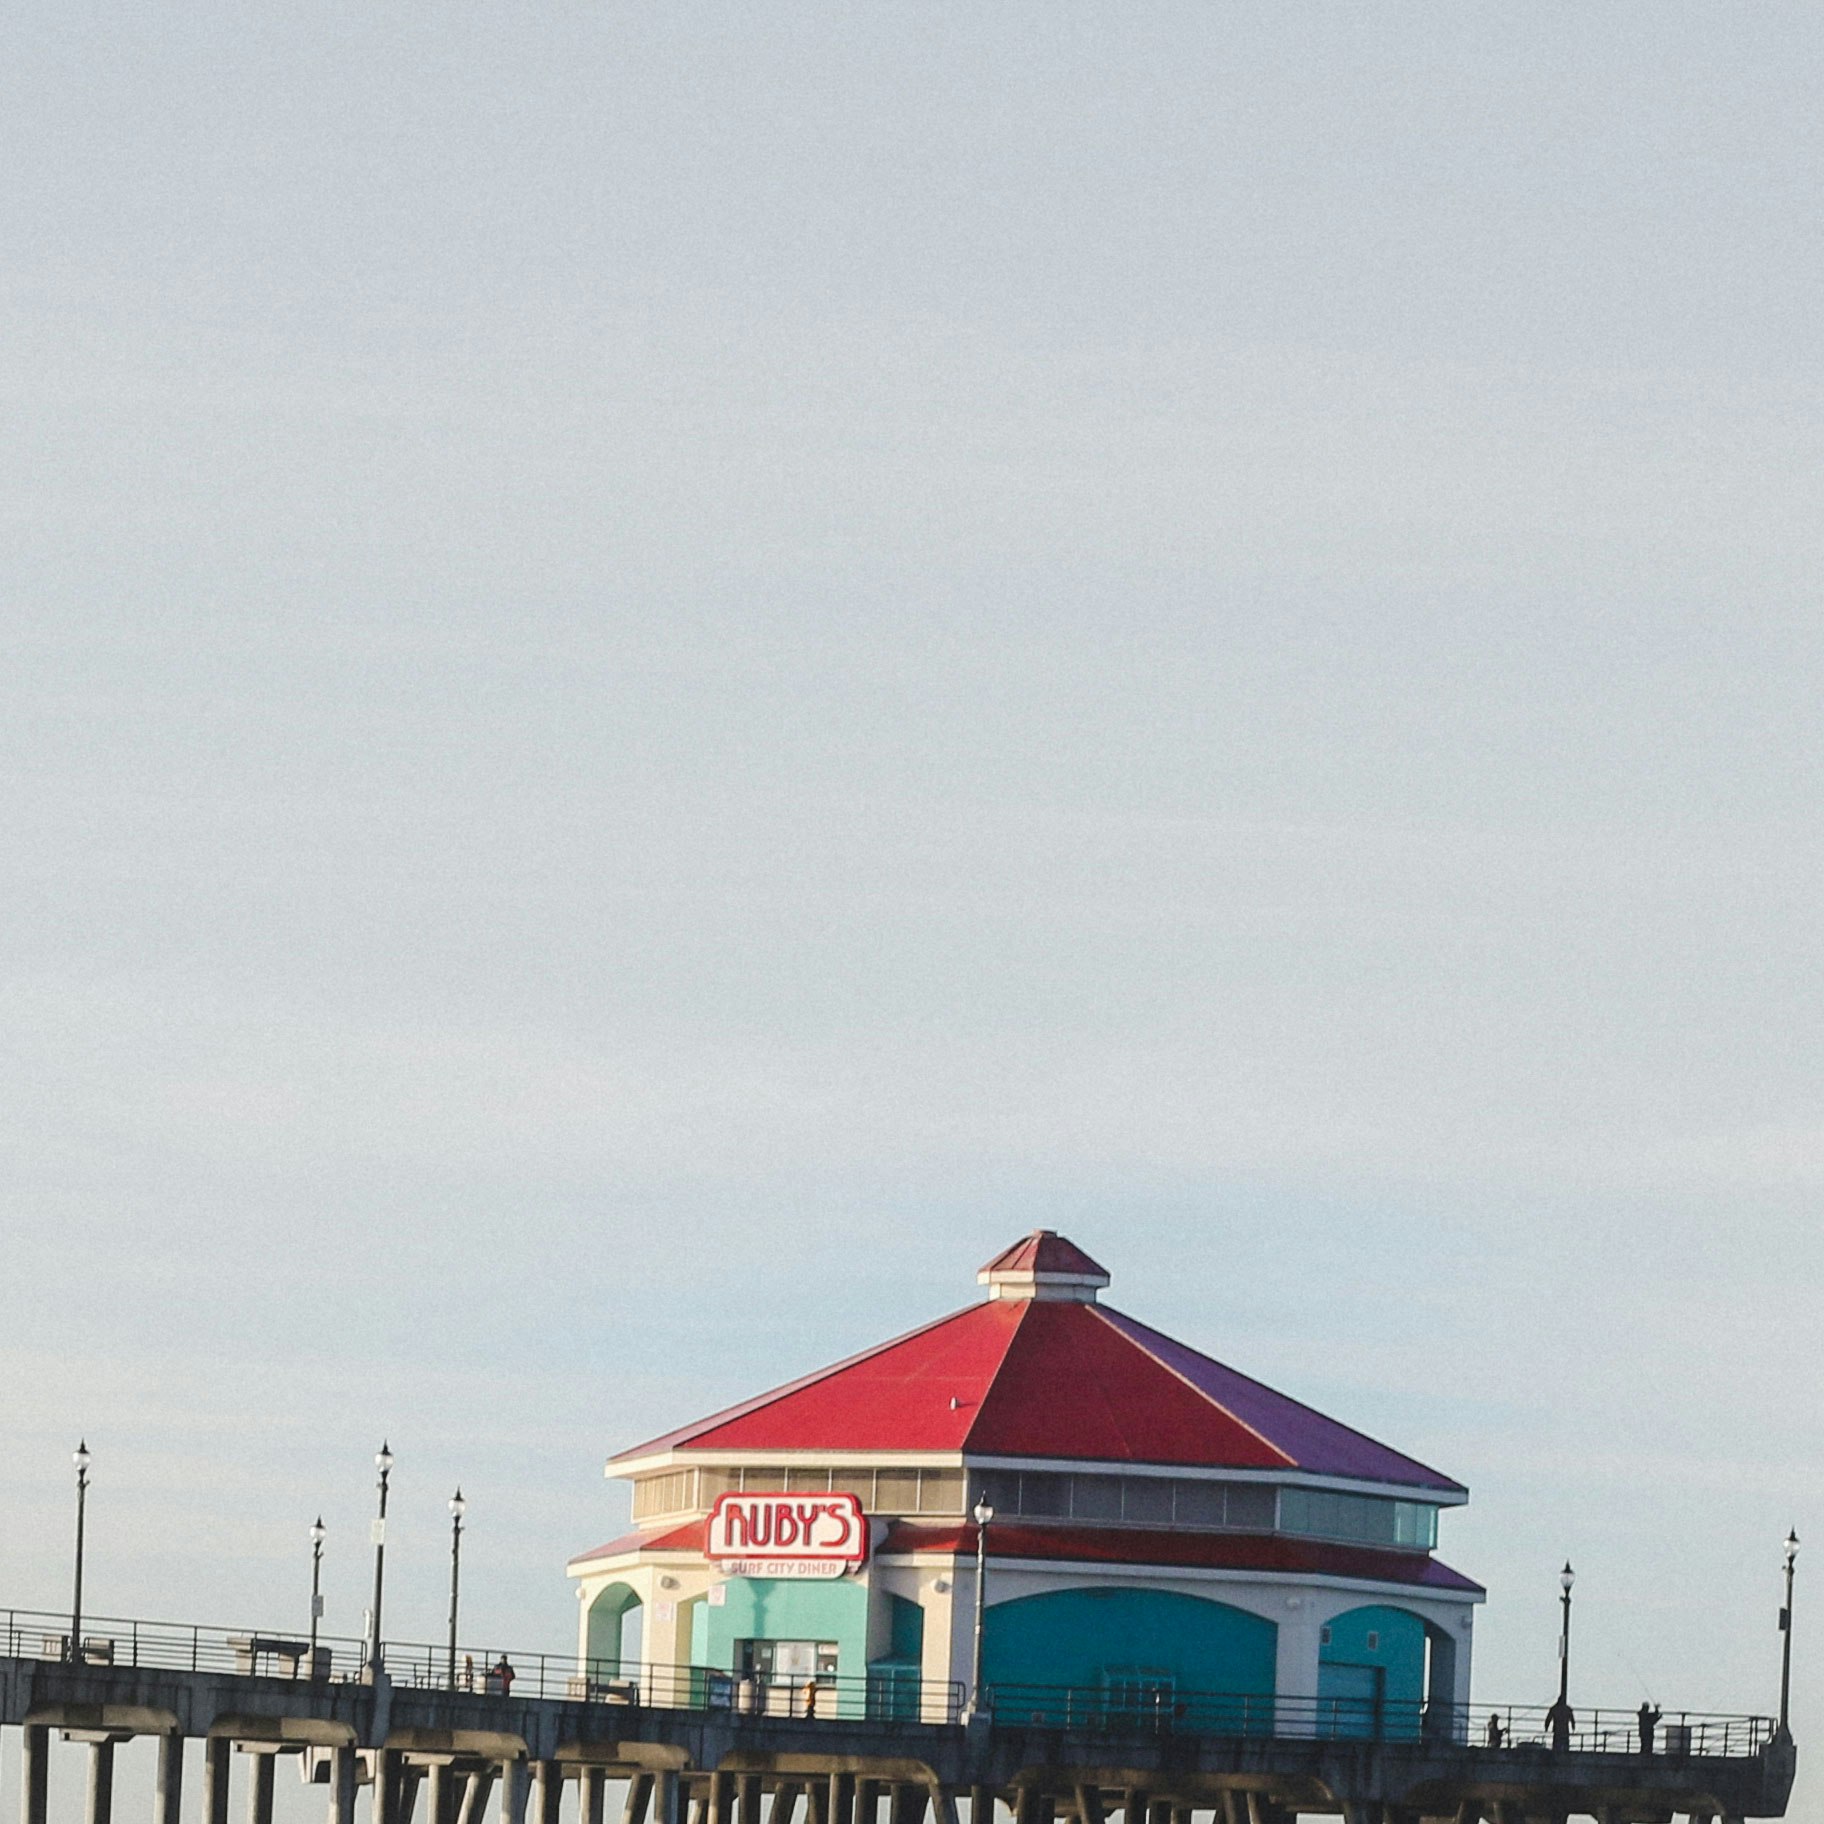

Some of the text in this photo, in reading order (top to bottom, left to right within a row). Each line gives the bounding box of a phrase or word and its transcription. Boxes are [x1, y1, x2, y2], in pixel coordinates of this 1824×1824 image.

[725, 1503, 850, 1547] RUBY'S
[731, 1561, 837, 1575] SURF CITY DINER
